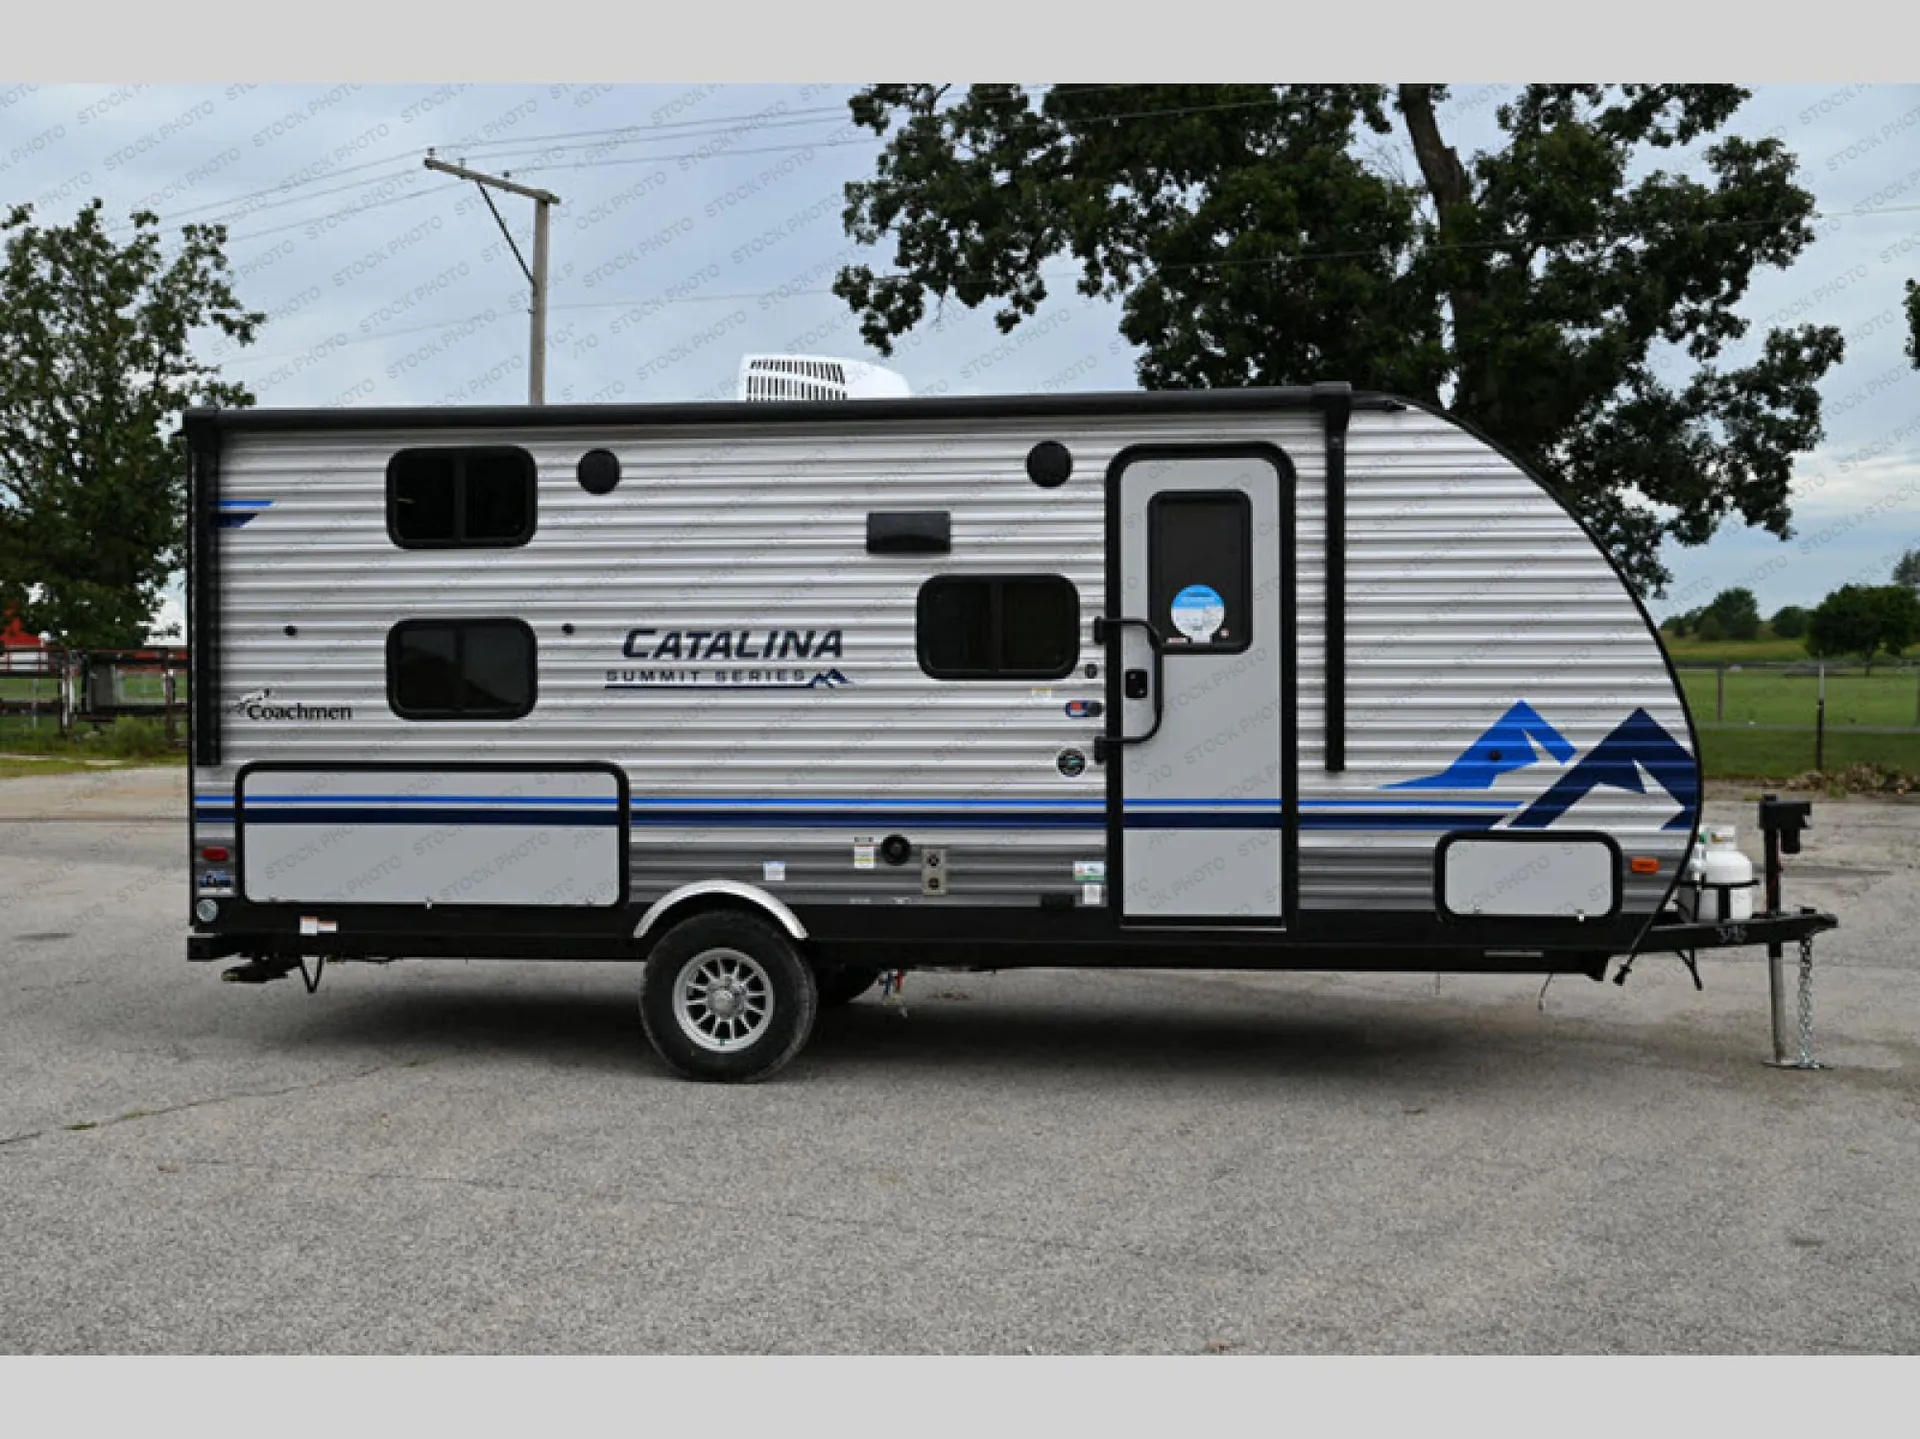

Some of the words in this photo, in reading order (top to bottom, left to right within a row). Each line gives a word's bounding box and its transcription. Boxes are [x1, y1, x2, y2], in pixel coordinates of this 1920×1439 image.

[621, 628, 844, 659] CATALINA
[606, 668, 700, 682] SUMMIT
[714, 668, 805, 682] SERIES
[246, 702, 353, 720] Coachmen
